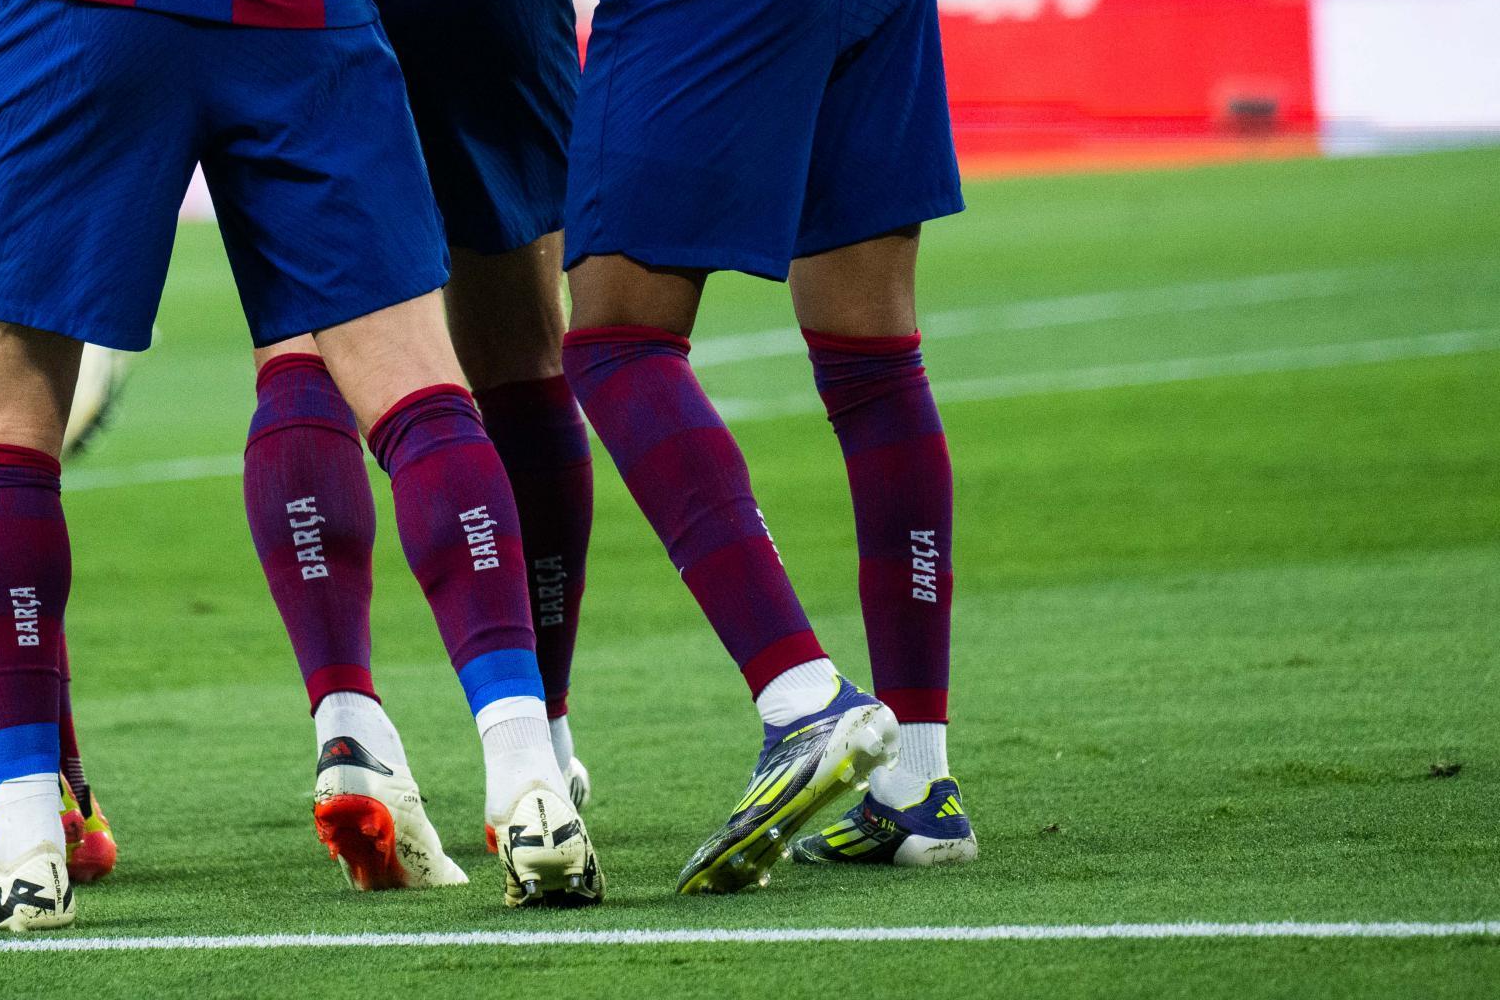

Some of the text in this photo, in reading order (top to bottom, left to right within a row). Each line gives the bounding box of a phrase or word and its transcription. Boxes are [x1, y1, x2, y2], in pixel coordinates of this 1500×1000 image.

[284, 496, 329, 580] BARÇA
[458, 505, 500, 572] BARÇA
[909, 529, 940, 603] BARÇA
[9, 586, 42, 647] BARÇA
[534, 555, 568, 627] BARÇA
